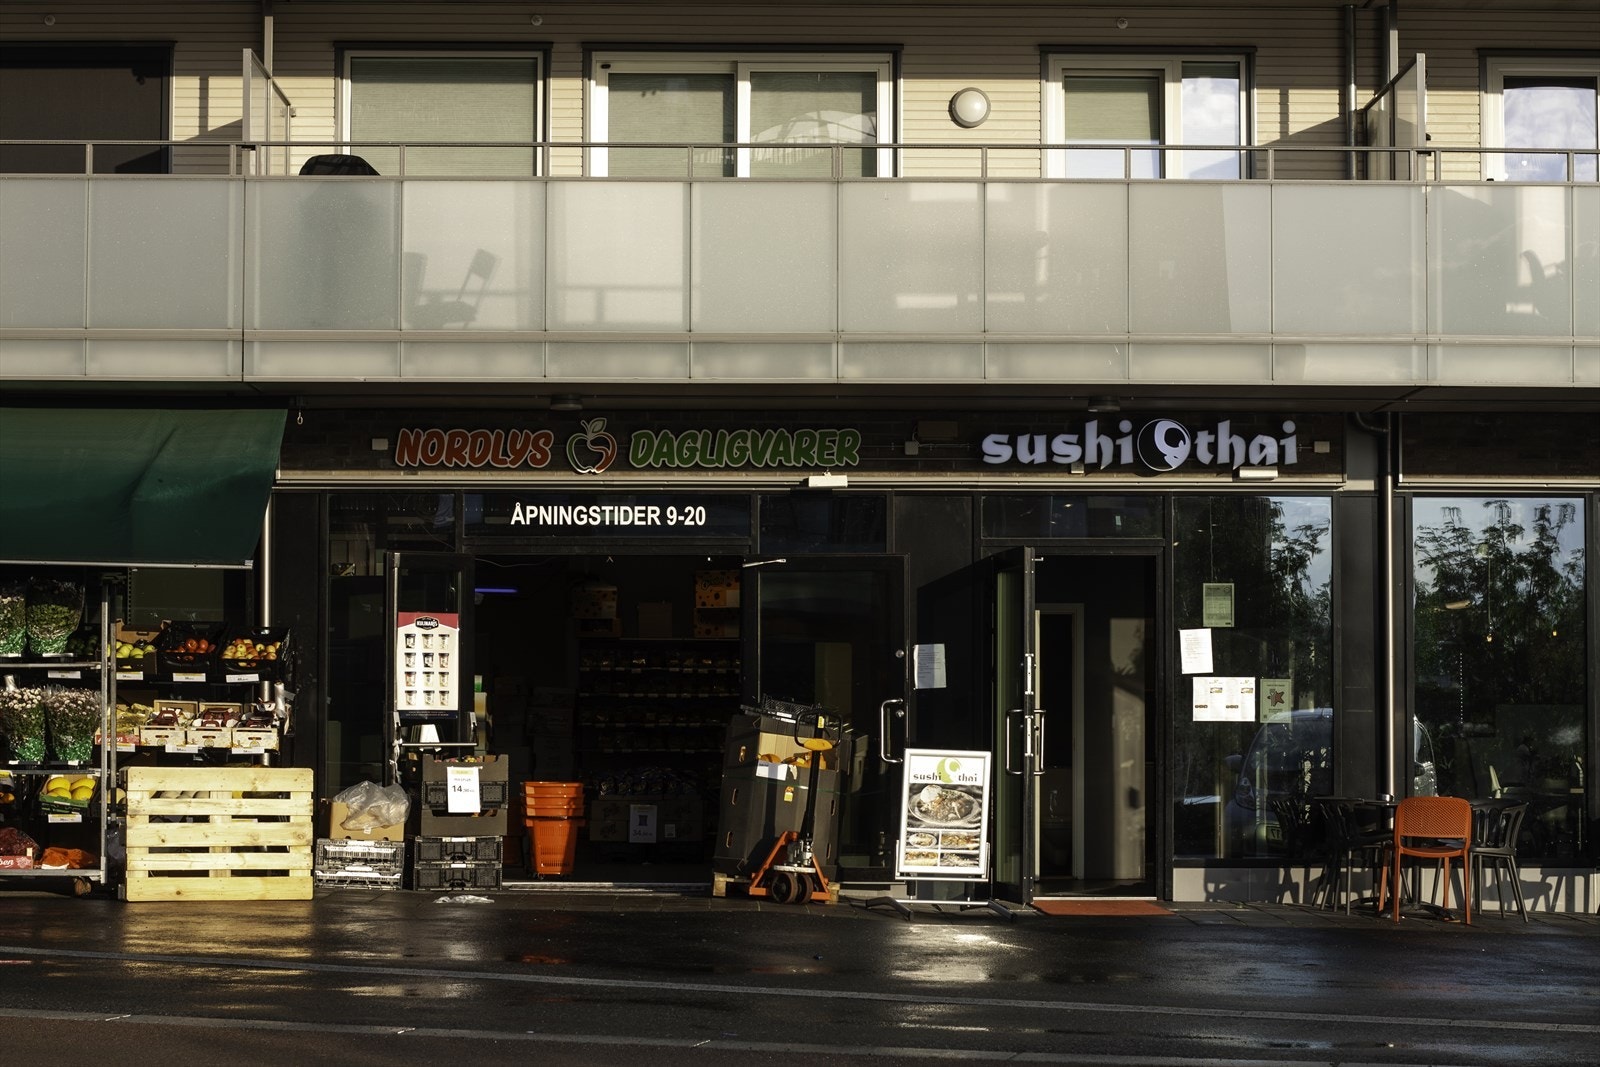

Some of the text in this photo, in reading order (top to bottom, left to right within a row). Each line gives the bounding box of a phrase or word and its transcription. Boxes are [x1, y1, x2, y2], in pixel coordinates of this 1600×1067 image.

[396, 428, 861, 468] NORDLYS DAGLIGVARER
[981, 419, 1297, 470] sushi thai
[510, 502, 707, 526] ÅPNINGSTIDER 9-20
[913, 772, 978, 782] sushi thai
